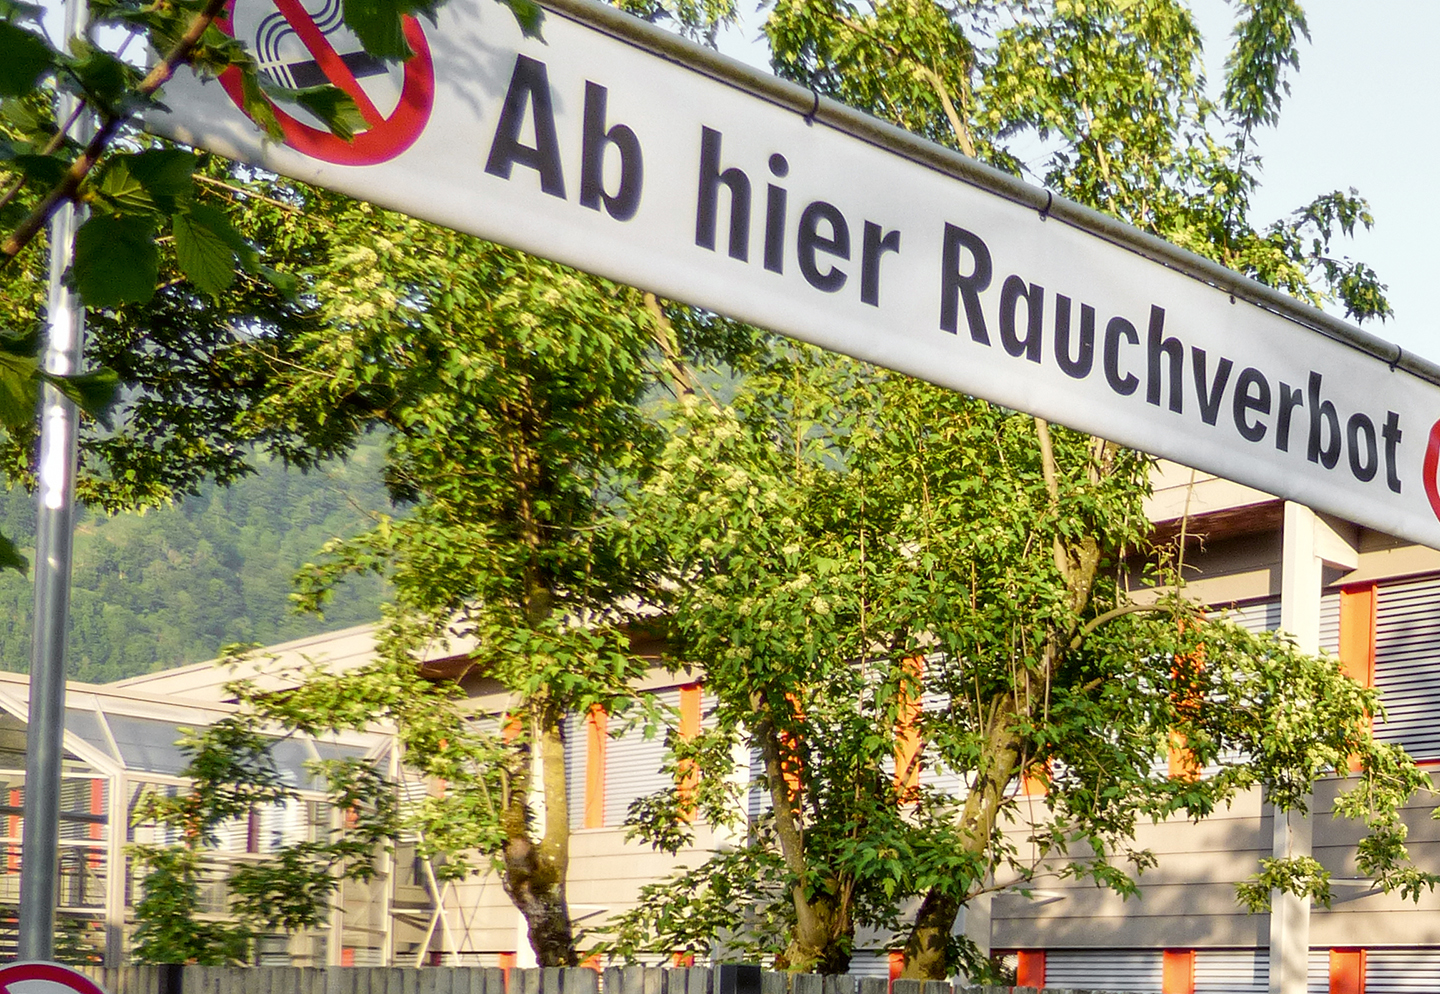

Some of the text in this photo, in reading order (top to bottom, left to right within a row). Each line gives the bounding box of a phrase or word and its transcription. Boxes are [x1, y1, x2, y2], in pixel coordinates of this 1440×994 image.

[484, 53, 1403, 495] Ab hier Rauchverbot
